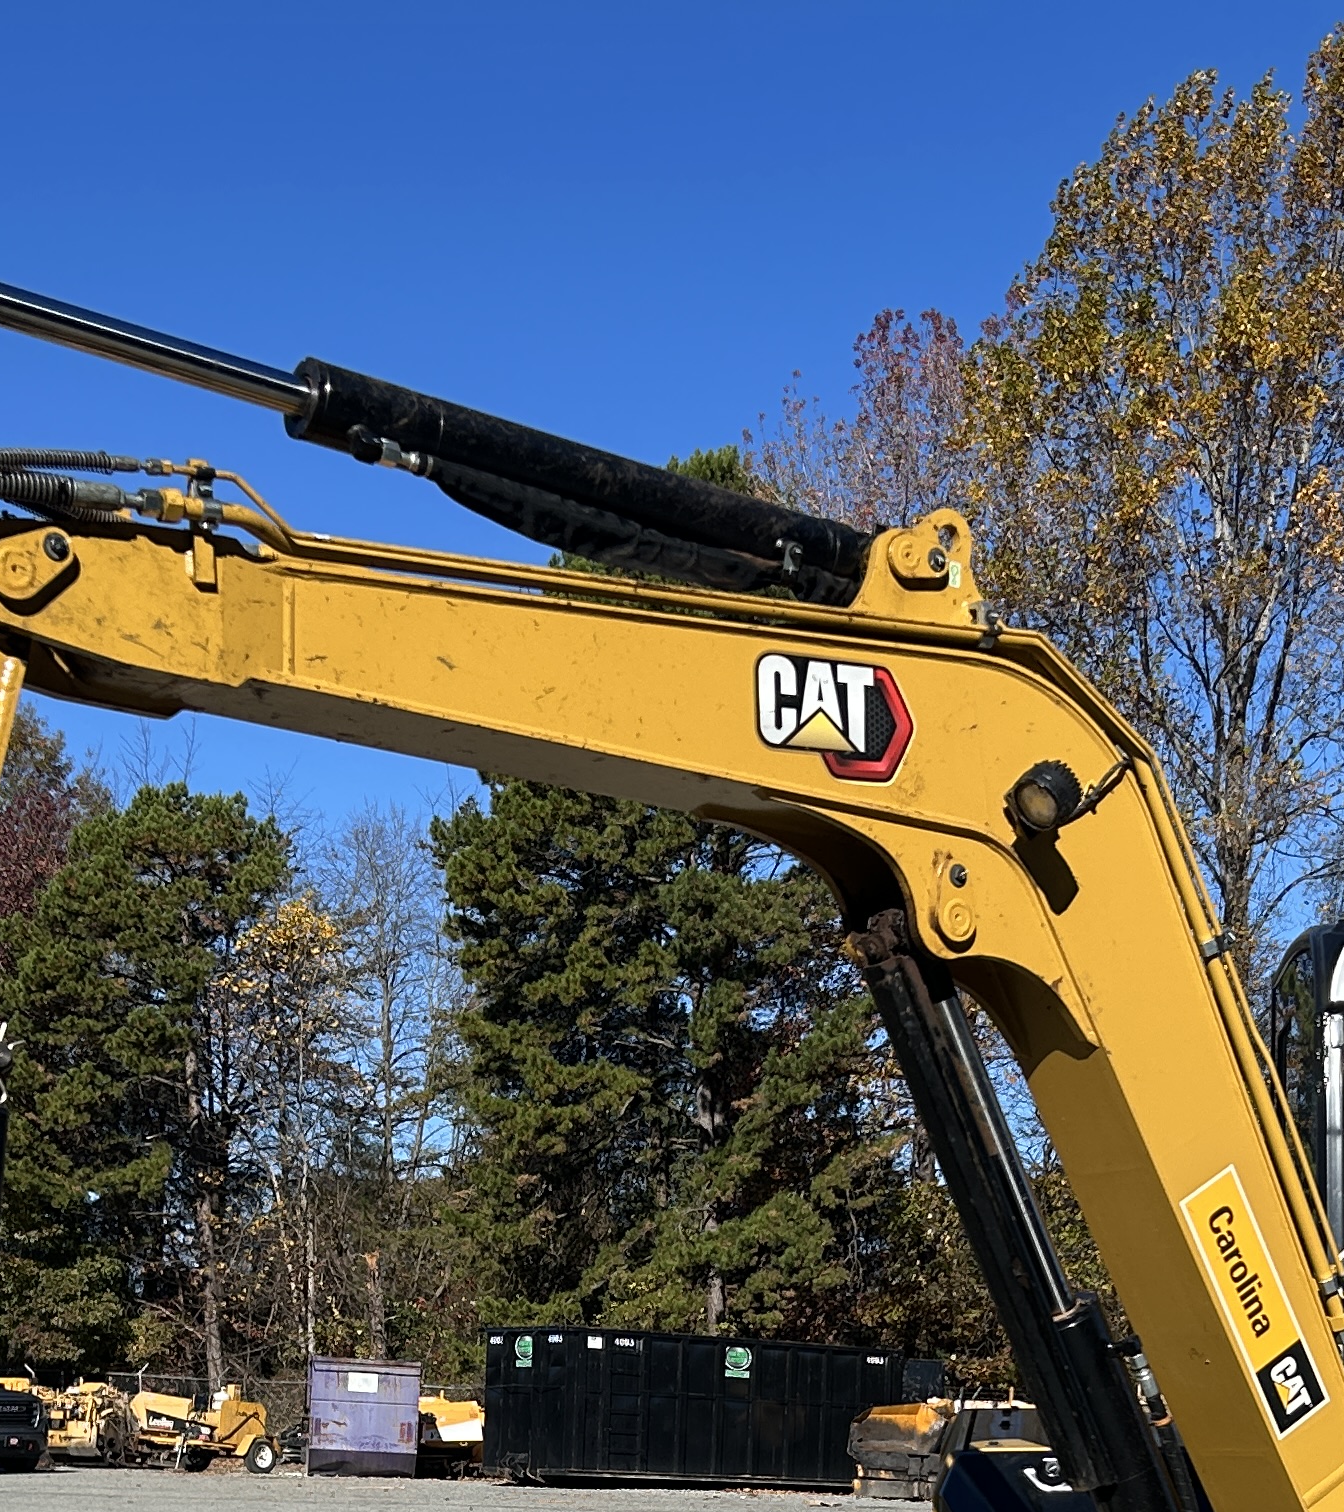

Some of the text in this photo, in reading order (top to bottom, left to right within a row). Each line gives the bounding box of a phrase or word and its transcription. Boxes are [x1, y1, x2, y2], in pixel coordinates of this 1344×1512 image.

[758, 655, 875, 753] CAT
[1208, 1205, 1271, 1339] Carolina
[1270, 1356, 1312, 1416] CAT
